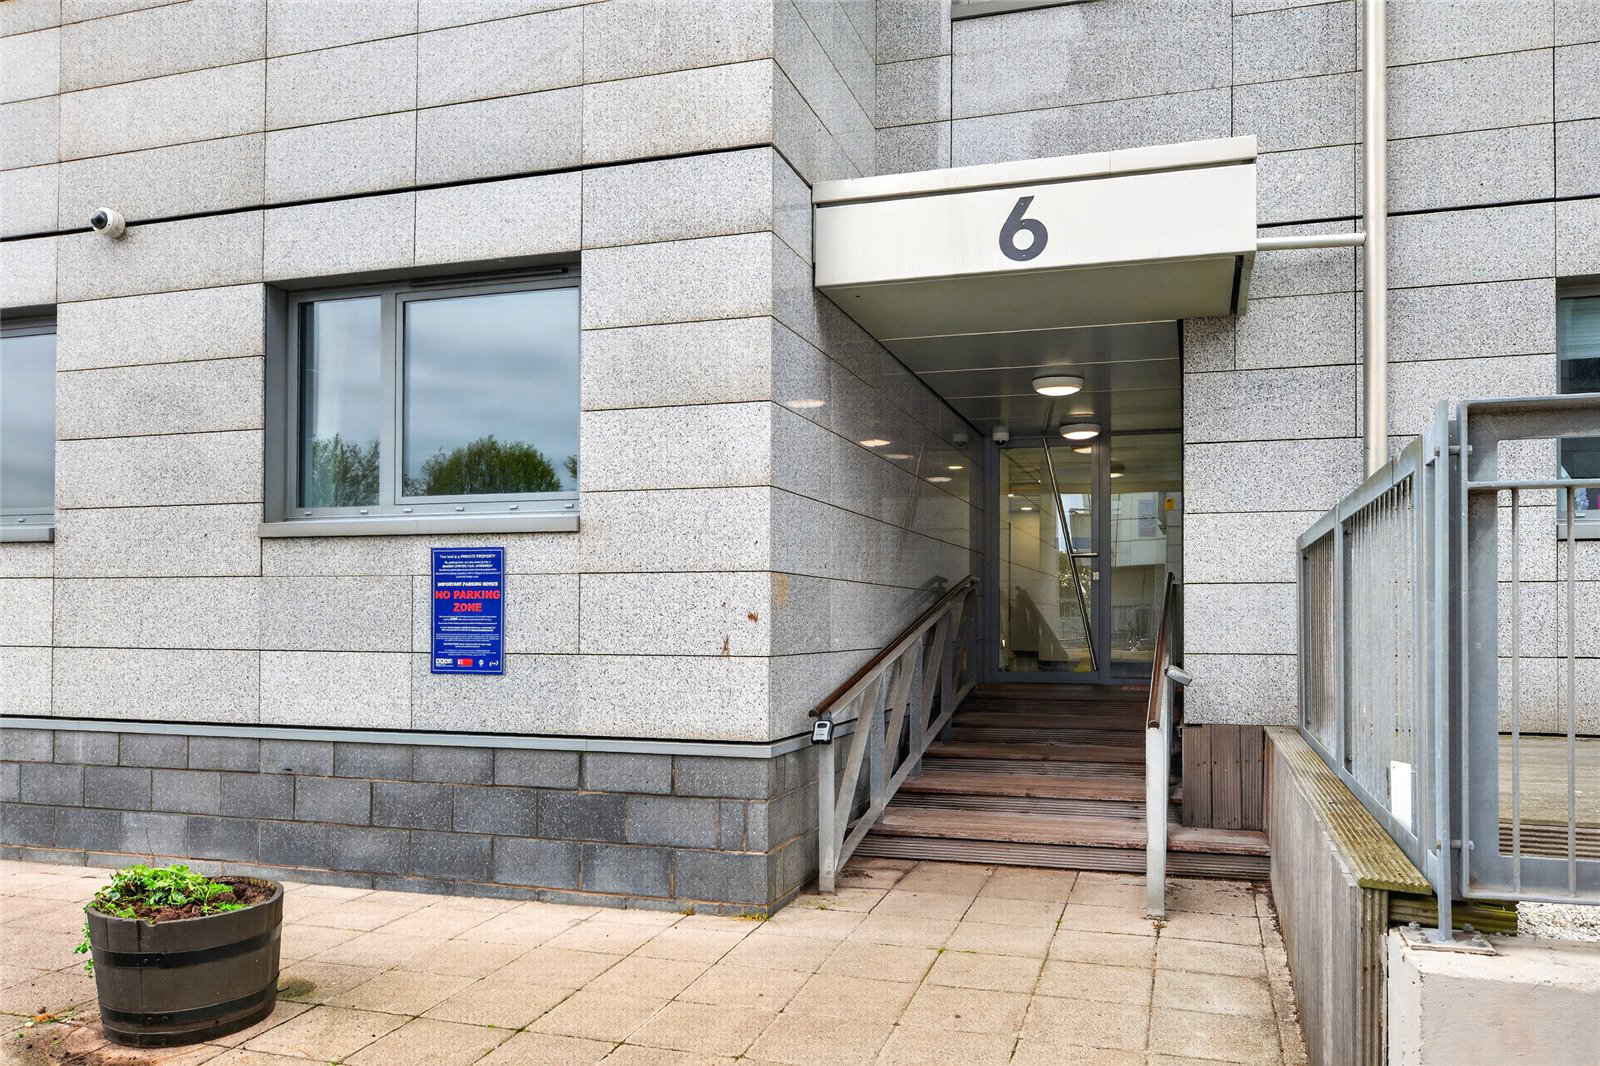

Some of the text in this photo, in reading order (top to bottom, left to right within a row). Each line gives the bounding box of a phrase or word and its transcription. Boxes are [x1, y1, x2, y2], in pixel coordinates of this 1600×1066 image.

[999, 195, 1048, 262] 6
[435, 590, 501, 599] NO PARKING
[453, 602, 482, 612] ZONE
